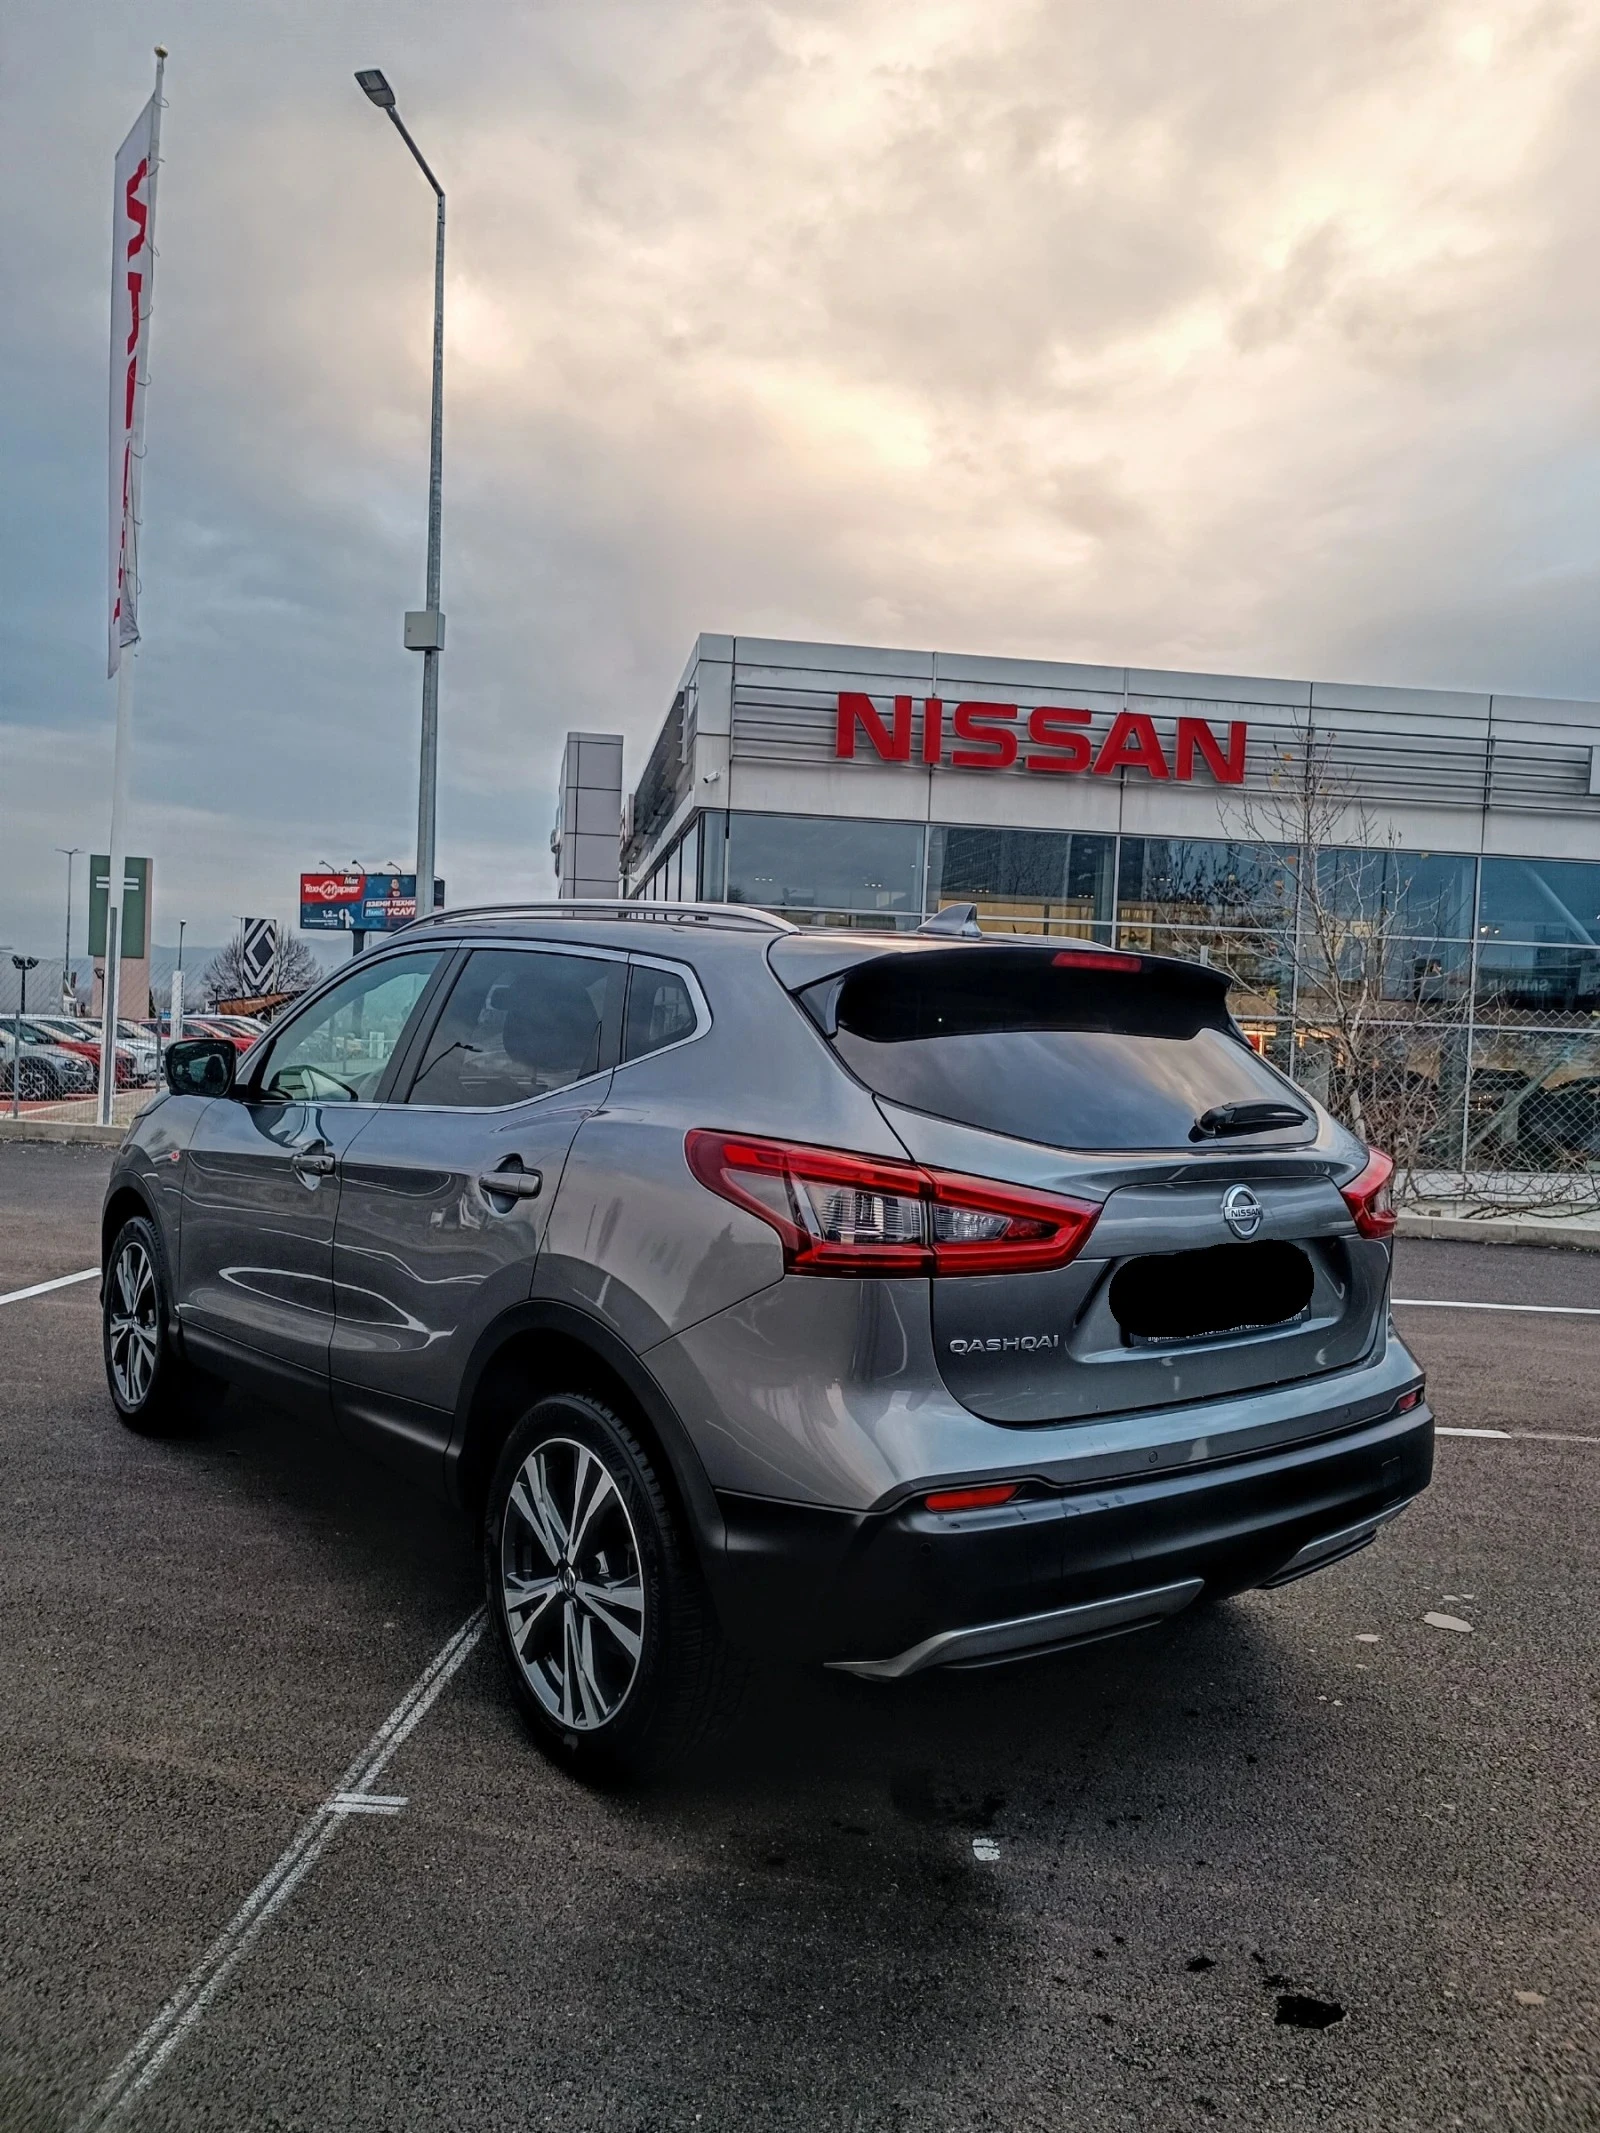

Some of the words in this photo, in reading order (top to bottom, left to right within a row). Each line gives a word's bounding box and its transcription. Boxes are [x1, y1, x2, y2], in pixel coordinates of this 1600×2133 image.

[835, 691, 1247, 784] NISSAN
[1231, 1208, 1260, 1217] NISSAN
[950, 1335, 1059, 1355] QASHQAI
